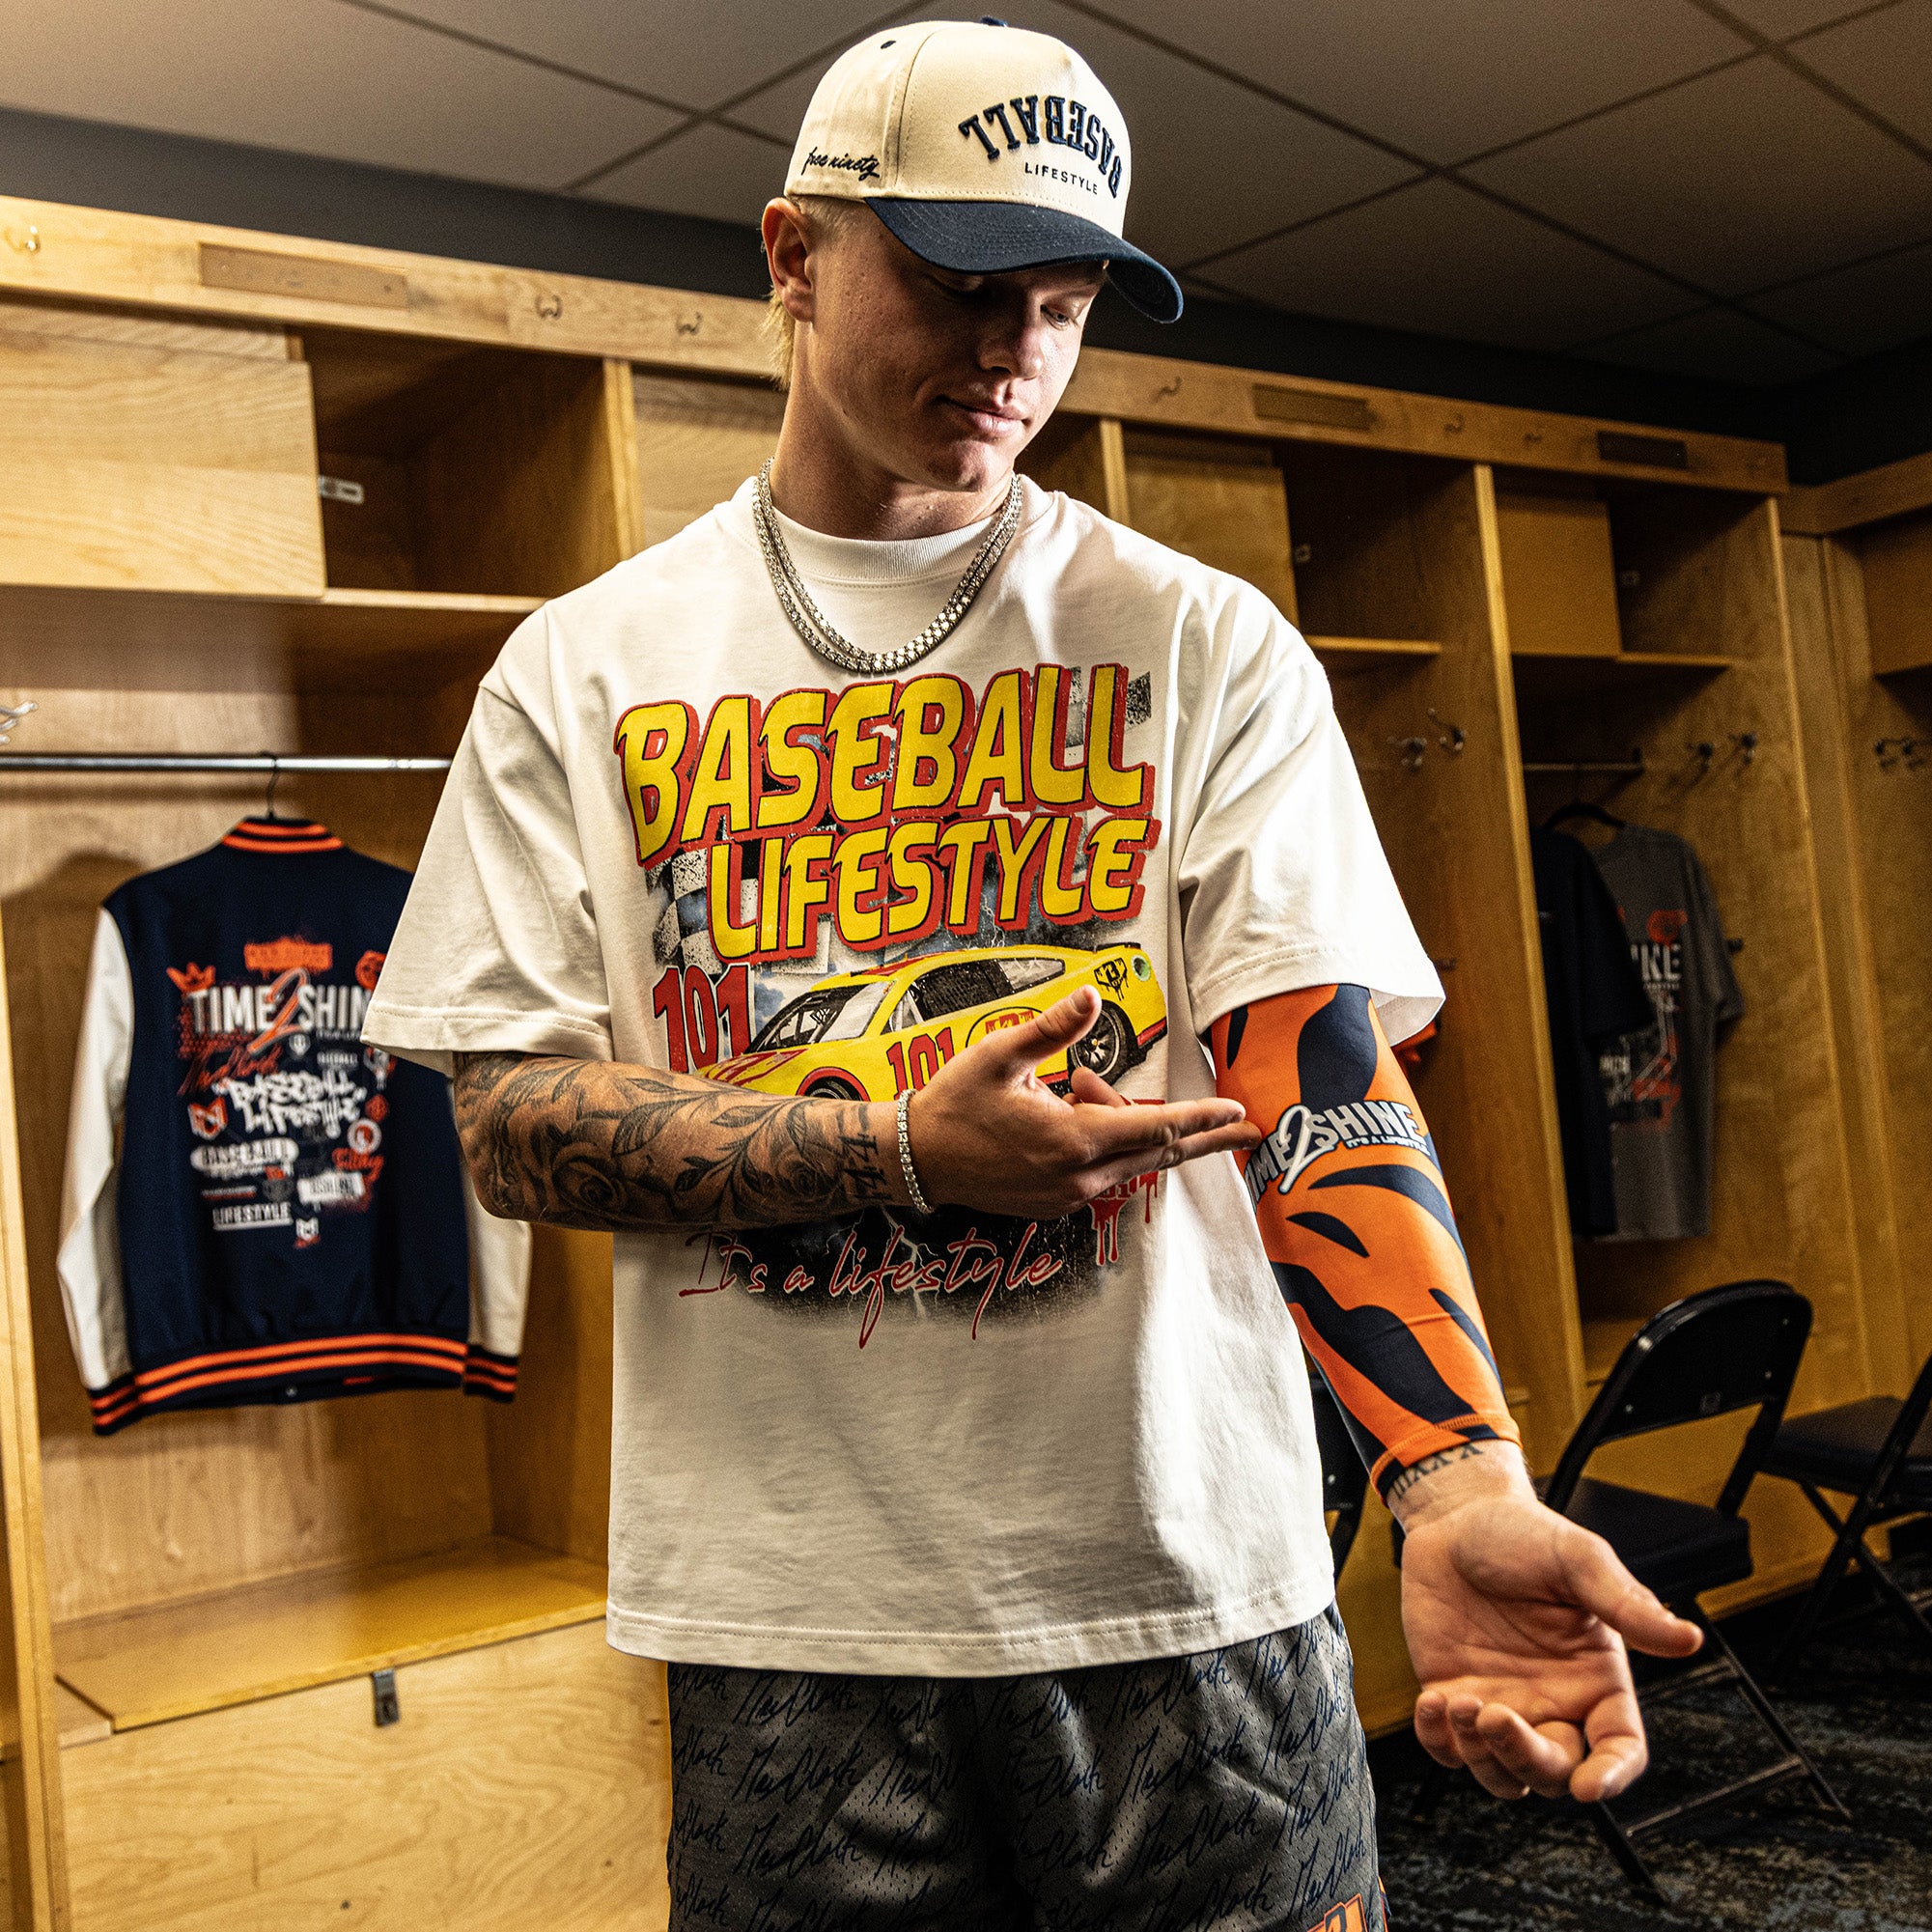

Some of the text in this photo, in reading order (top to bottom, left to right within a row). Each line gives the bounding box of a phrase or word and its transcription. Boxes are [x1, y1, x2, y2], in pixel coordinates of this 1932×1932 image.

[801, 146, 881, 181] free ninety
[959, 95, 1123, 198] BASEBALL
[1024, 161, 1098, 195] LIFESTYLE
[614, 663, 1156, 869] BASEBALL
[706, 812, 1162, 965] LIFESTYLE
[652, 964, 756, 1075] 101
[783, 1271, 814, 1295] a
[829, 1221, 1064, 1350] lifestyle
